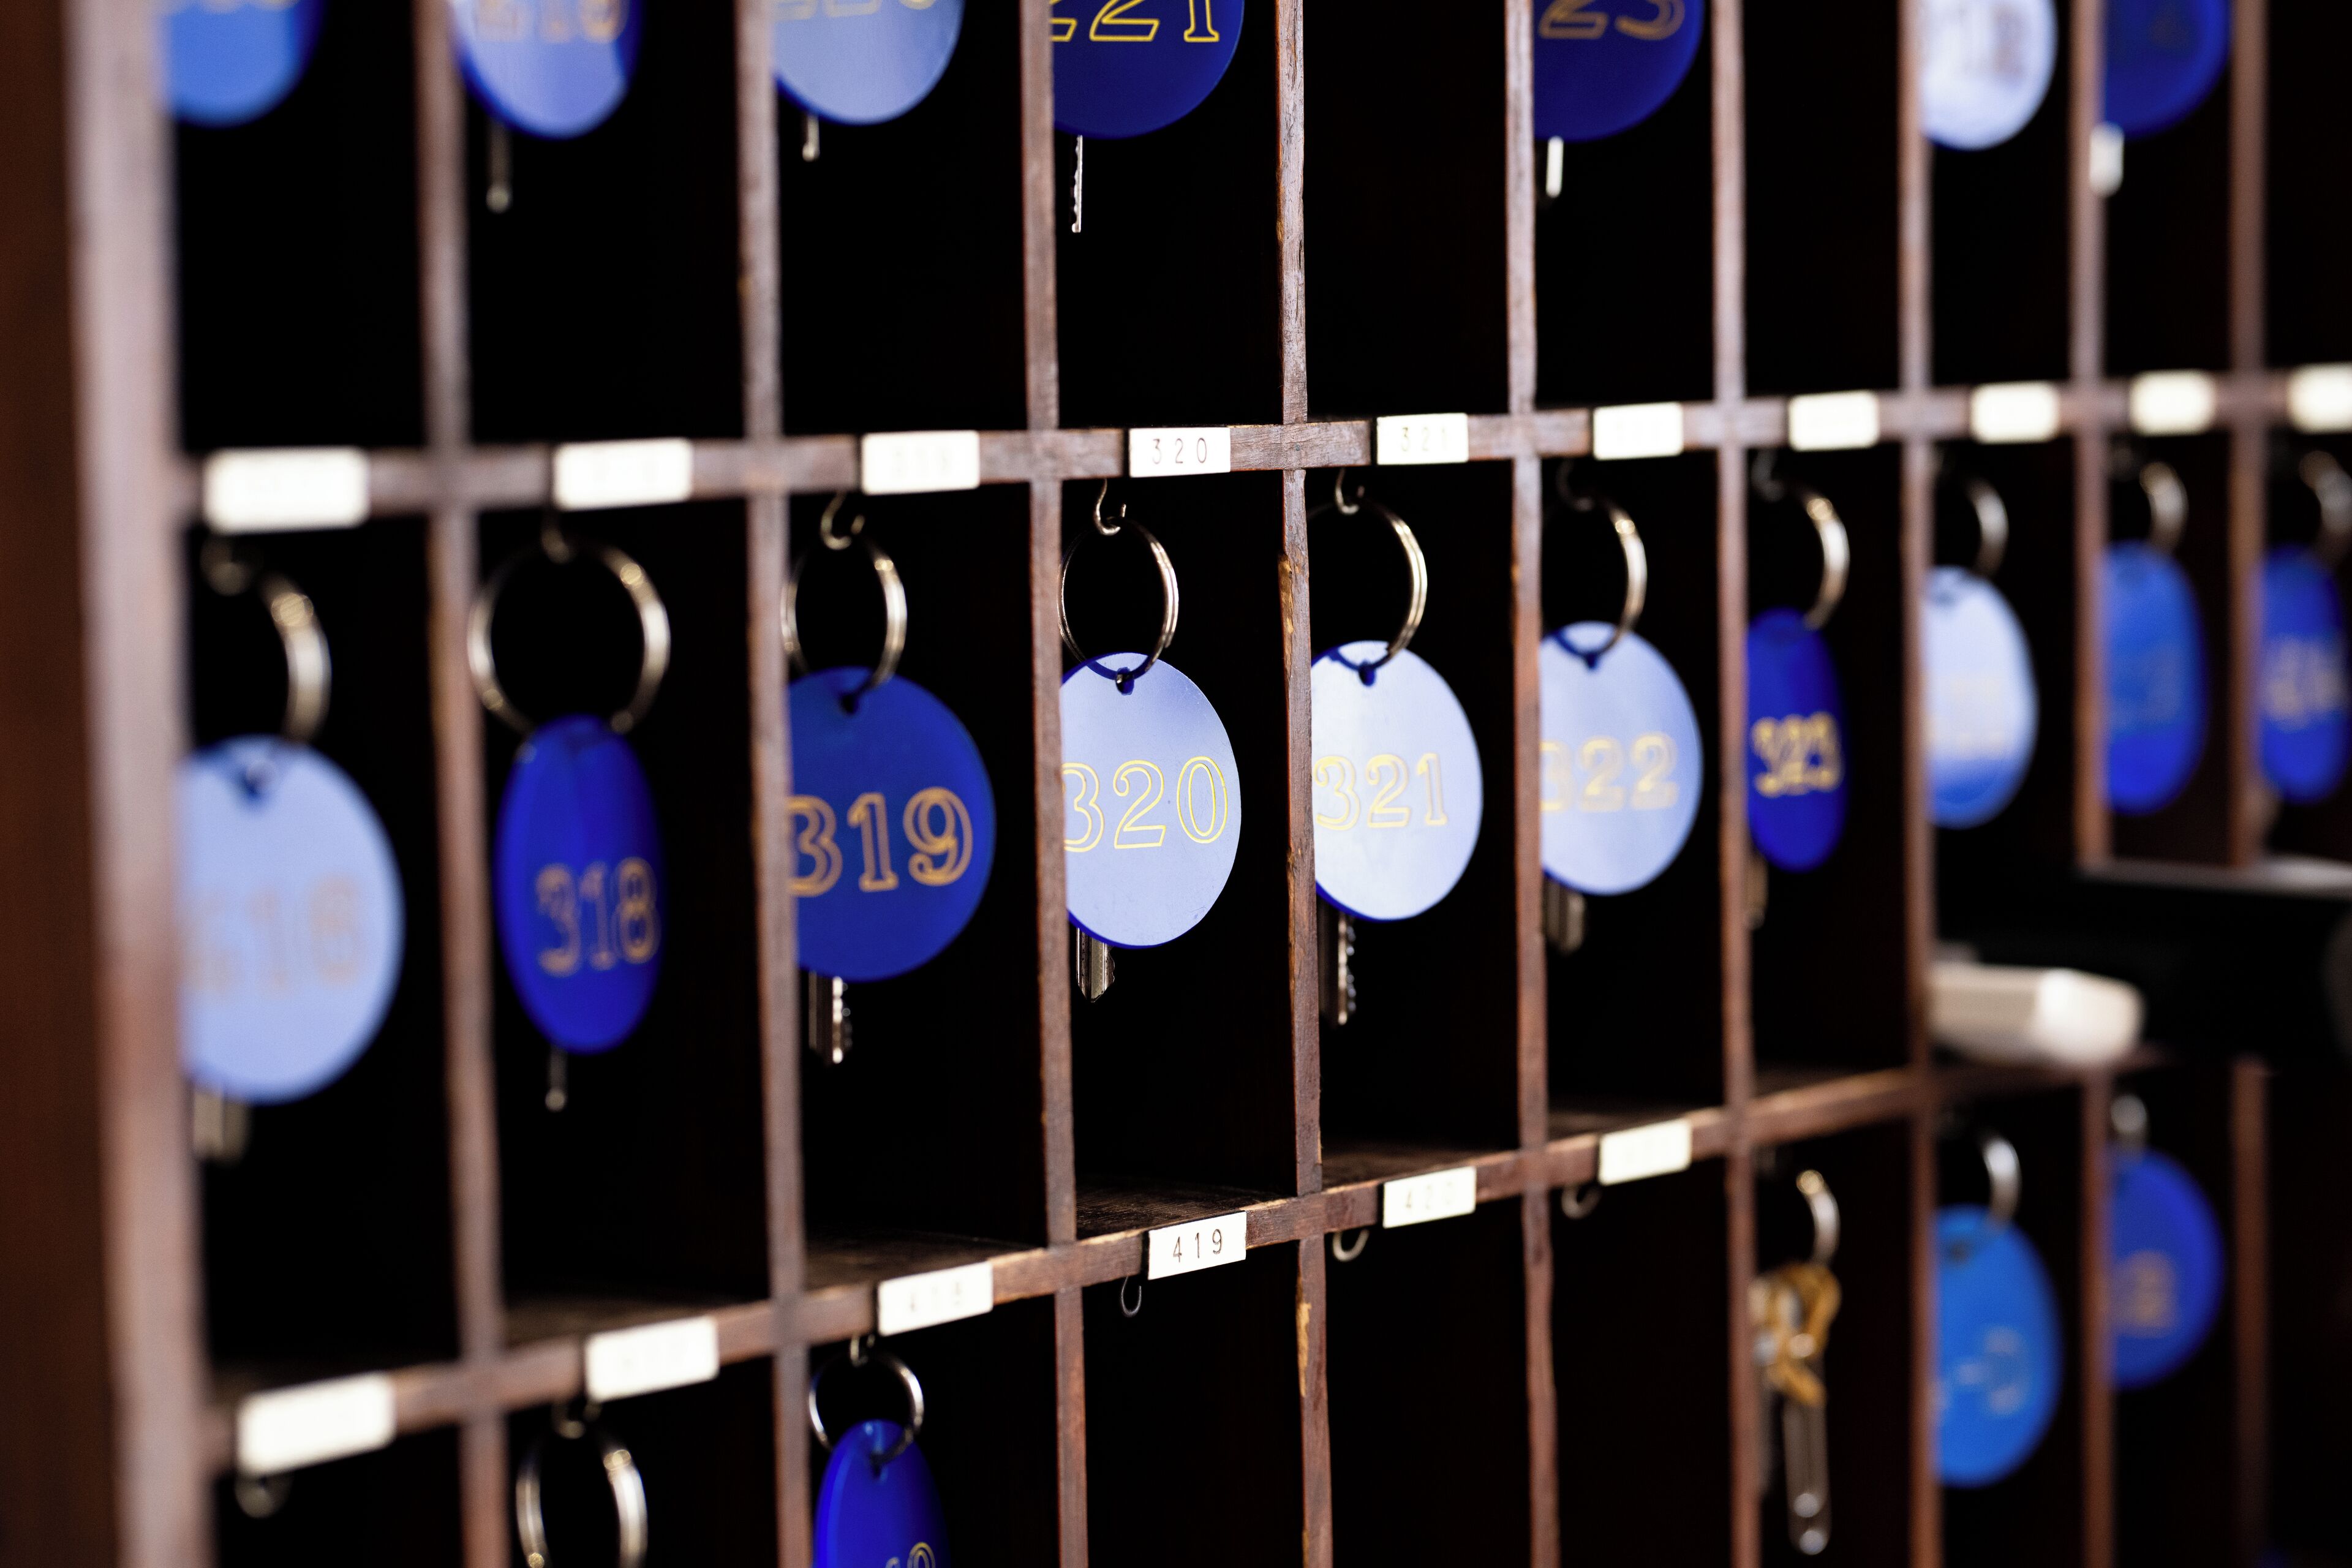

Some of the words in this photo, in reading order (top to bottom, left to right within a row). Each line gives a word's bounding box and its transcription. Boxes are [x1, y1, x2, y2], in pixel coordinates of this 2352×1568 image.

[1152, 437, 1207, 465] 320
[1401, 426, 1447, 452] 321
[1314, 753, 1449, 831] 321
[1540, 731, 1679, 813] 322
[1752, 712, 1844, 799] 323
[787, 786, 973, 898] 319
[1061, 756, 1228, 853] 320
[535, 856, 662, 978] 318
[1172, 1229, 1223, 1263] 419
